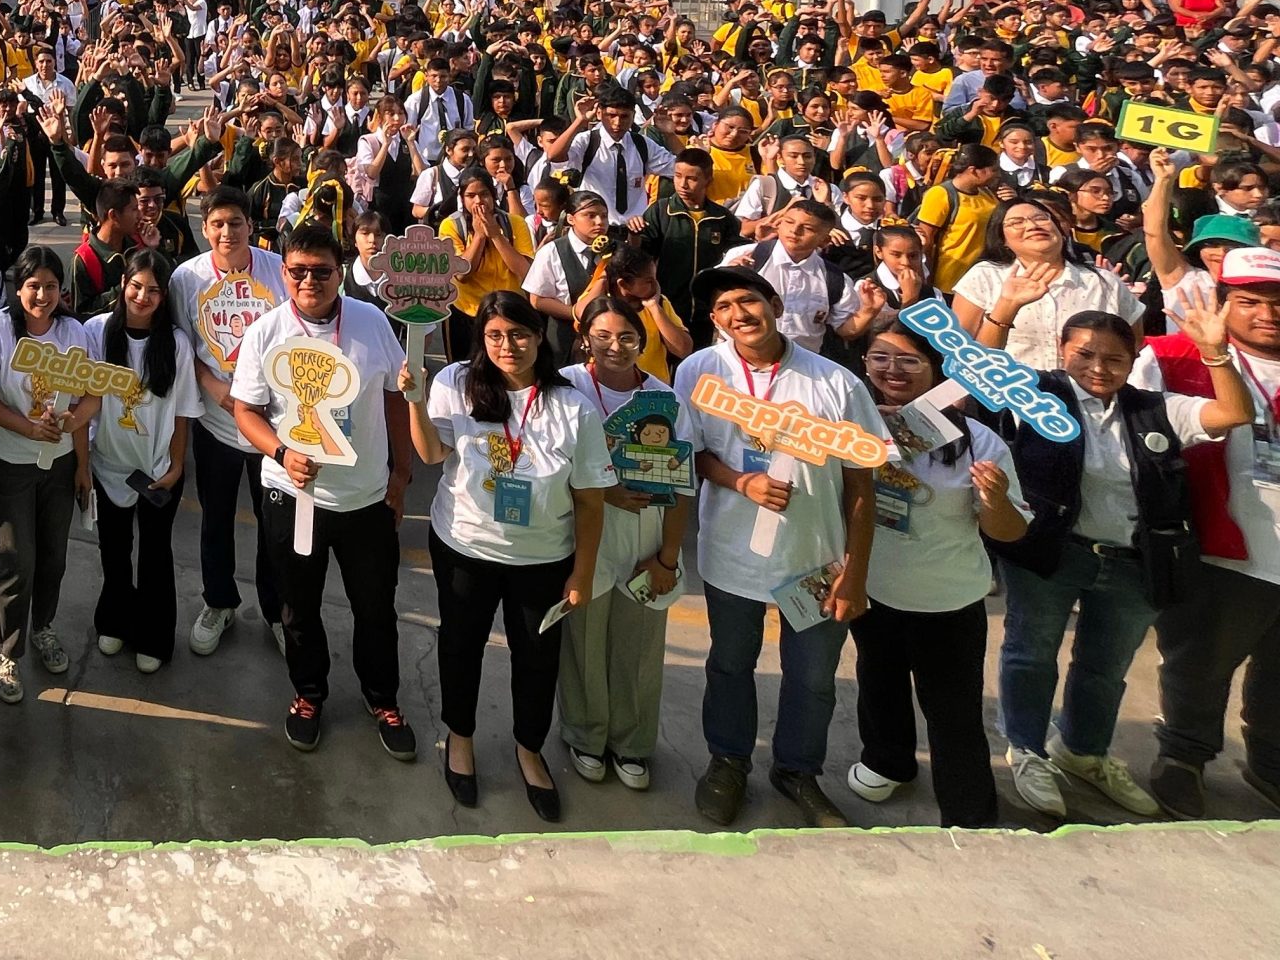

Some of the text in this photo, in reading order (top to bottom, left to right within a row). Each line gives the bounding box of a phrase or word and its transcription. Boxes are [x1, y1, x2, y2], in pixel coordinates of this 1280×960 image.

[15, 341, 133, 392] Dialoga
[292, 365, 330, 387] LO QUE
[293, 352, 333, 373] MERECES
[906, 303, 1073, 437] Decídete
[698, 378, 881, 461] Inspírate
